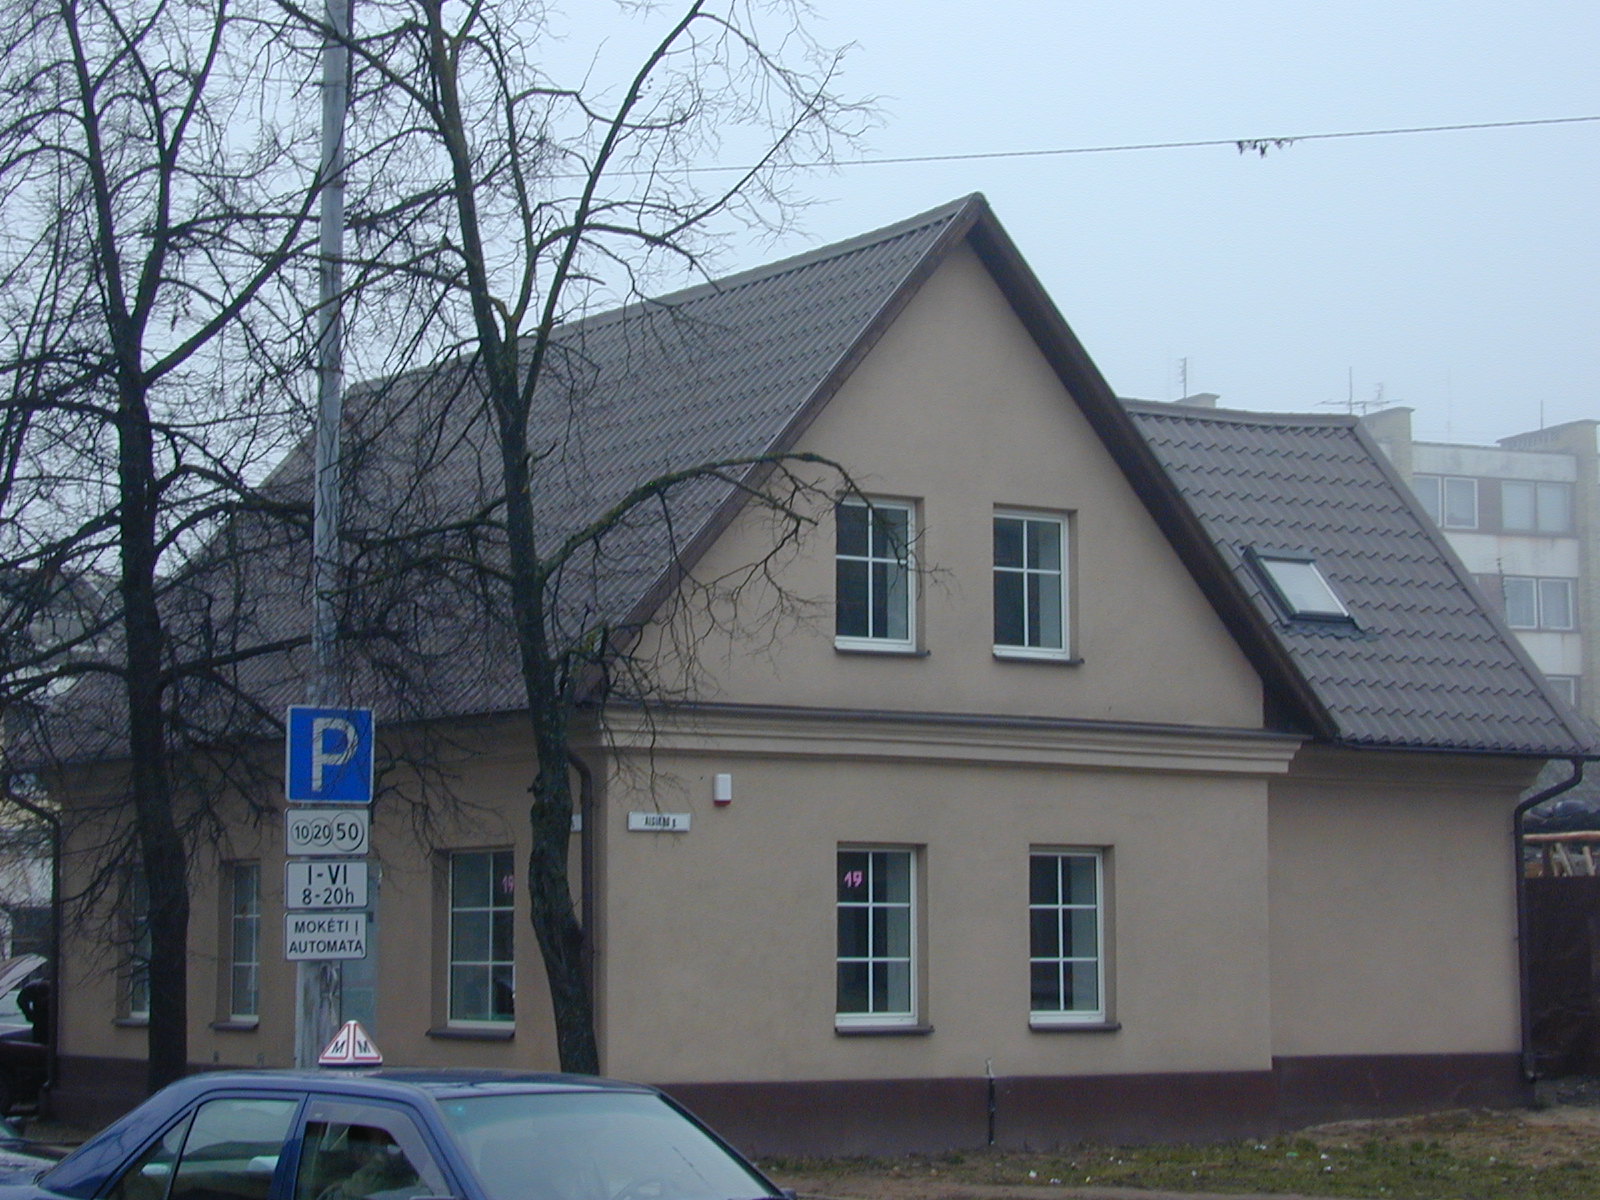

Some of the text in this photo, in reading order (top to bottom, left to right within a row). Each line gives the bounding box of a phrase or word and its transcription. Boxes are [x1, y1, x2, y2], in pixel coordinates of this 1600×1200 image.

[311, 717, 359, 793] P
[295, 822, 359, 841] 10 20 50
[331, 1040, 346, 1054] M
[356, 1040, 371, 1054] M
